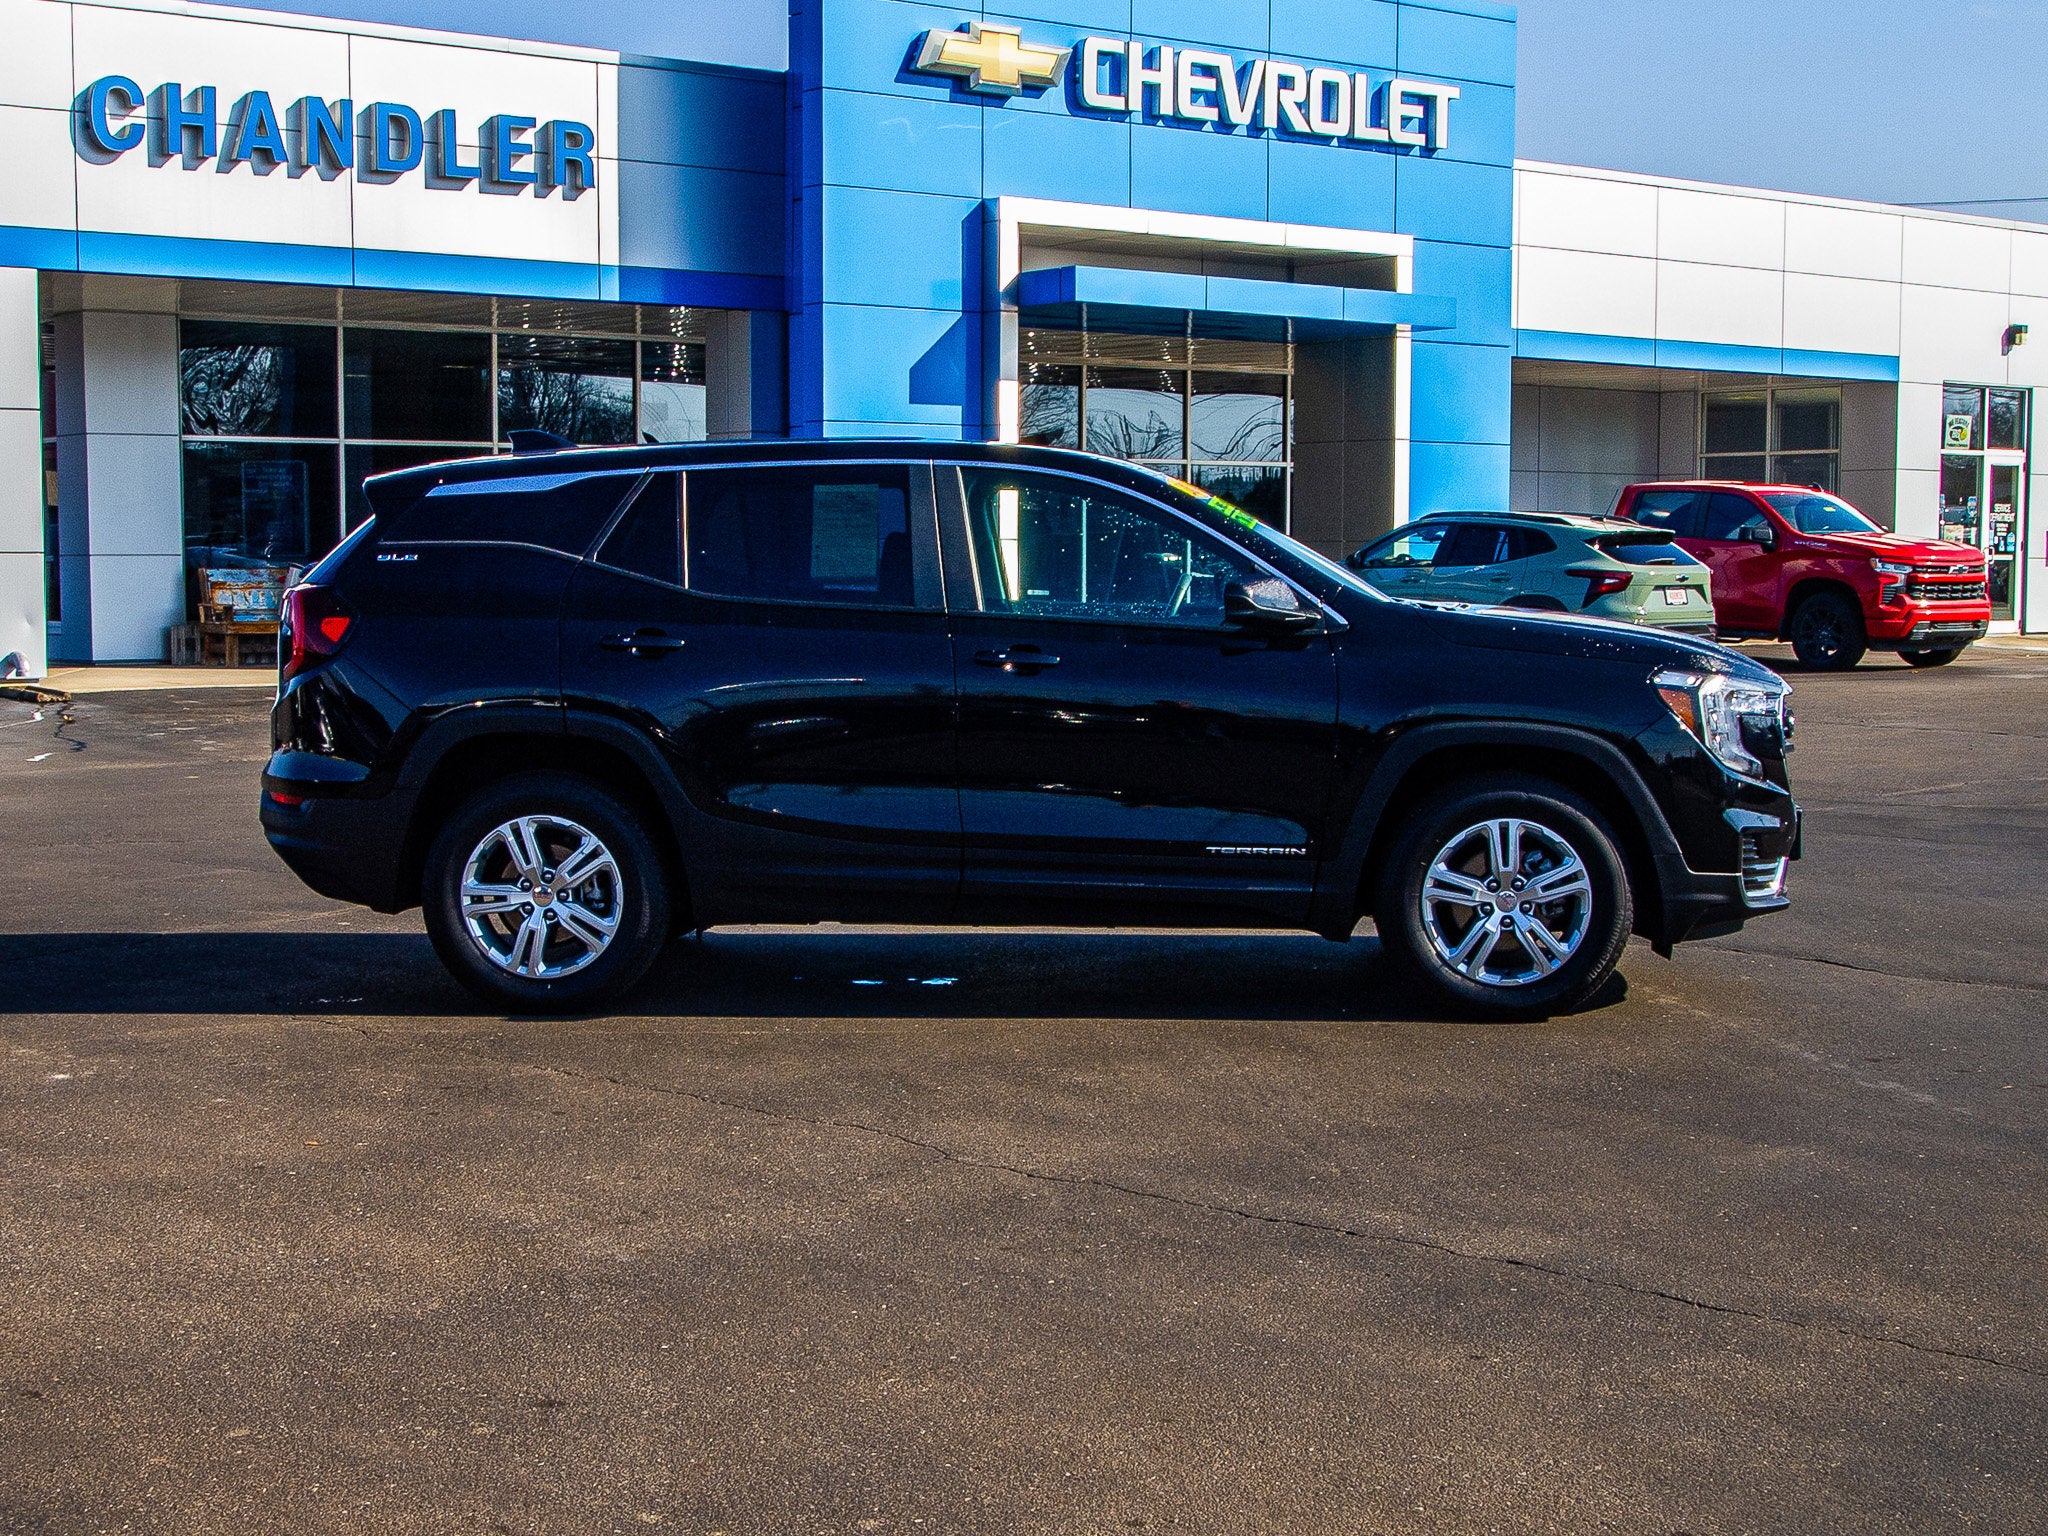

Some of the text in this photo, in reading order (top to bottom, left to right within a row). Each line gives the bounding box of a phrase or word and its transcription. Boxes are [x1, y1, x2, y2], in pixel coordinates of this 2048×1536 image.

[86, 75, 596, 191] CHANDLER
[1081, 36, 1461, 150] CHEVROLET
[1205, 846, 1307, 855] TERRAIN
